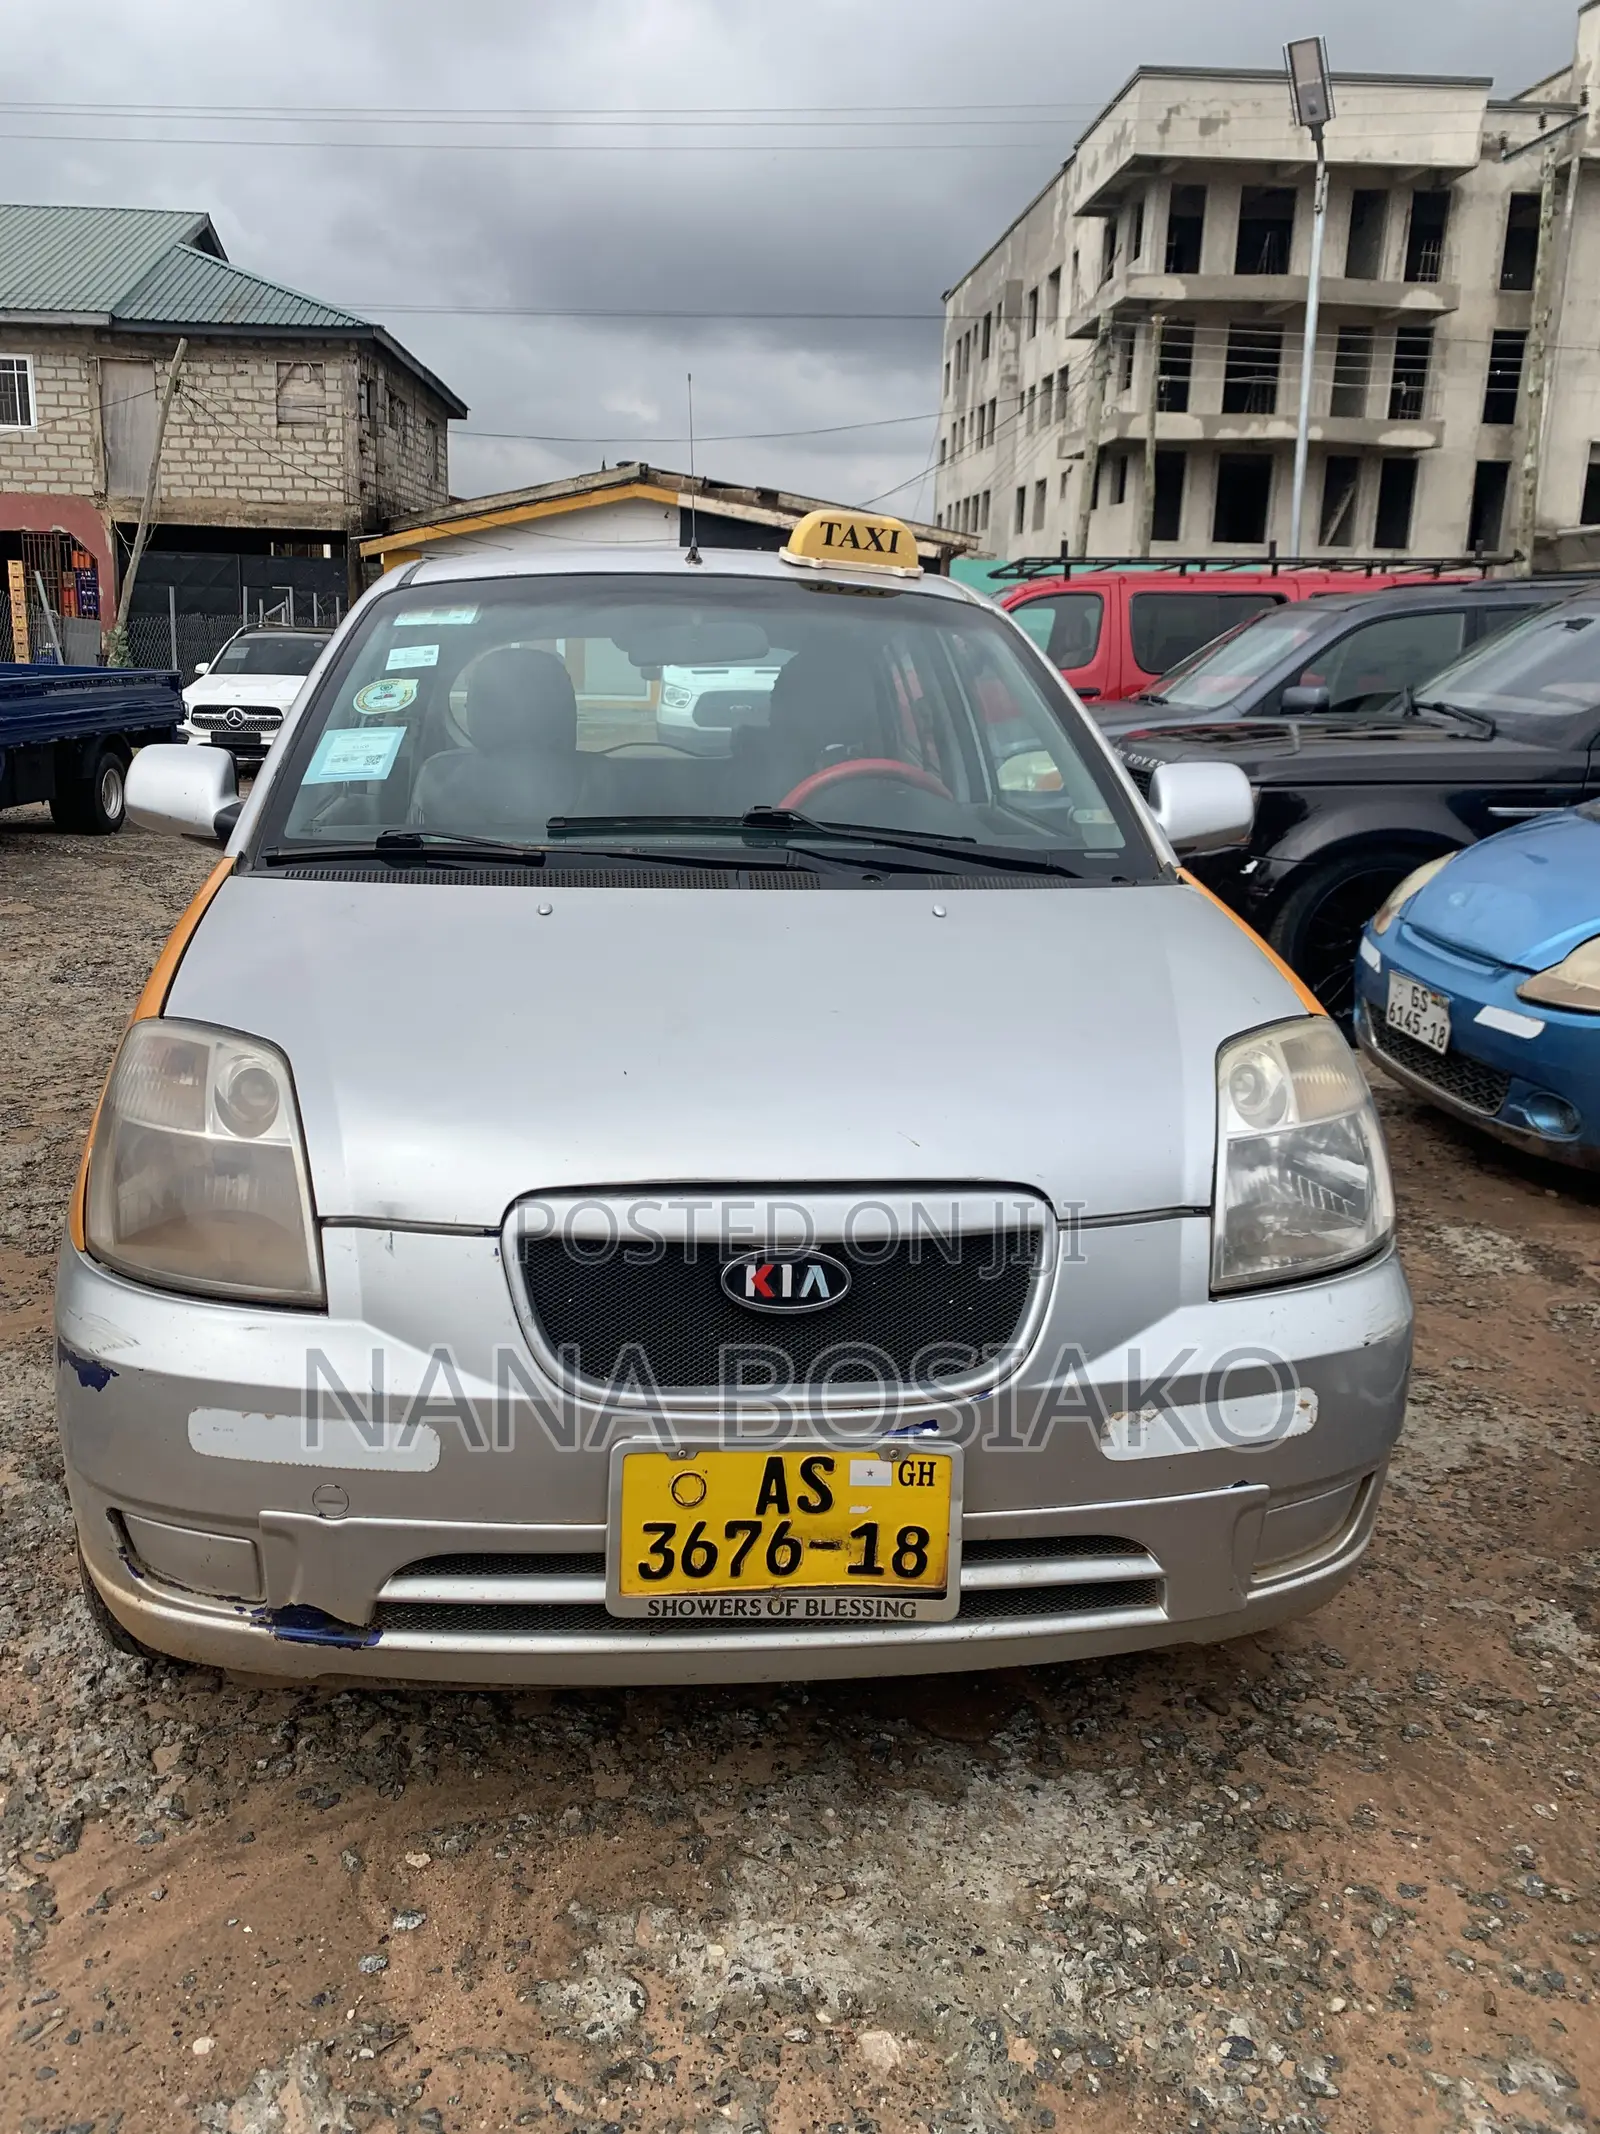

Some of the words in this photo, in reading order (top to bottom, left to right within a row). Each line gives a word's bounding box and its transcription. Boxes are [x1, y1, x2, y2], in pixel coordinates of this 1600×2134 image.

[820, 521, 902, 554] TAXI
[1411, 986, 1429, 1013] GS
[1388, 1002, 1446, 1046] 6145-18
[744, 1263, 831, 1299] KIA
[755, 1455, 836, 1516] AS
[898, 1460, 937, 1488] GH
[637, 1519, 931, 1581] 3676-18
[647, 1598, 762, 1618] SHOWERS
[766, 1598, 800, 1617] OF
[804, 1598, 917, 1620] BLESSING
